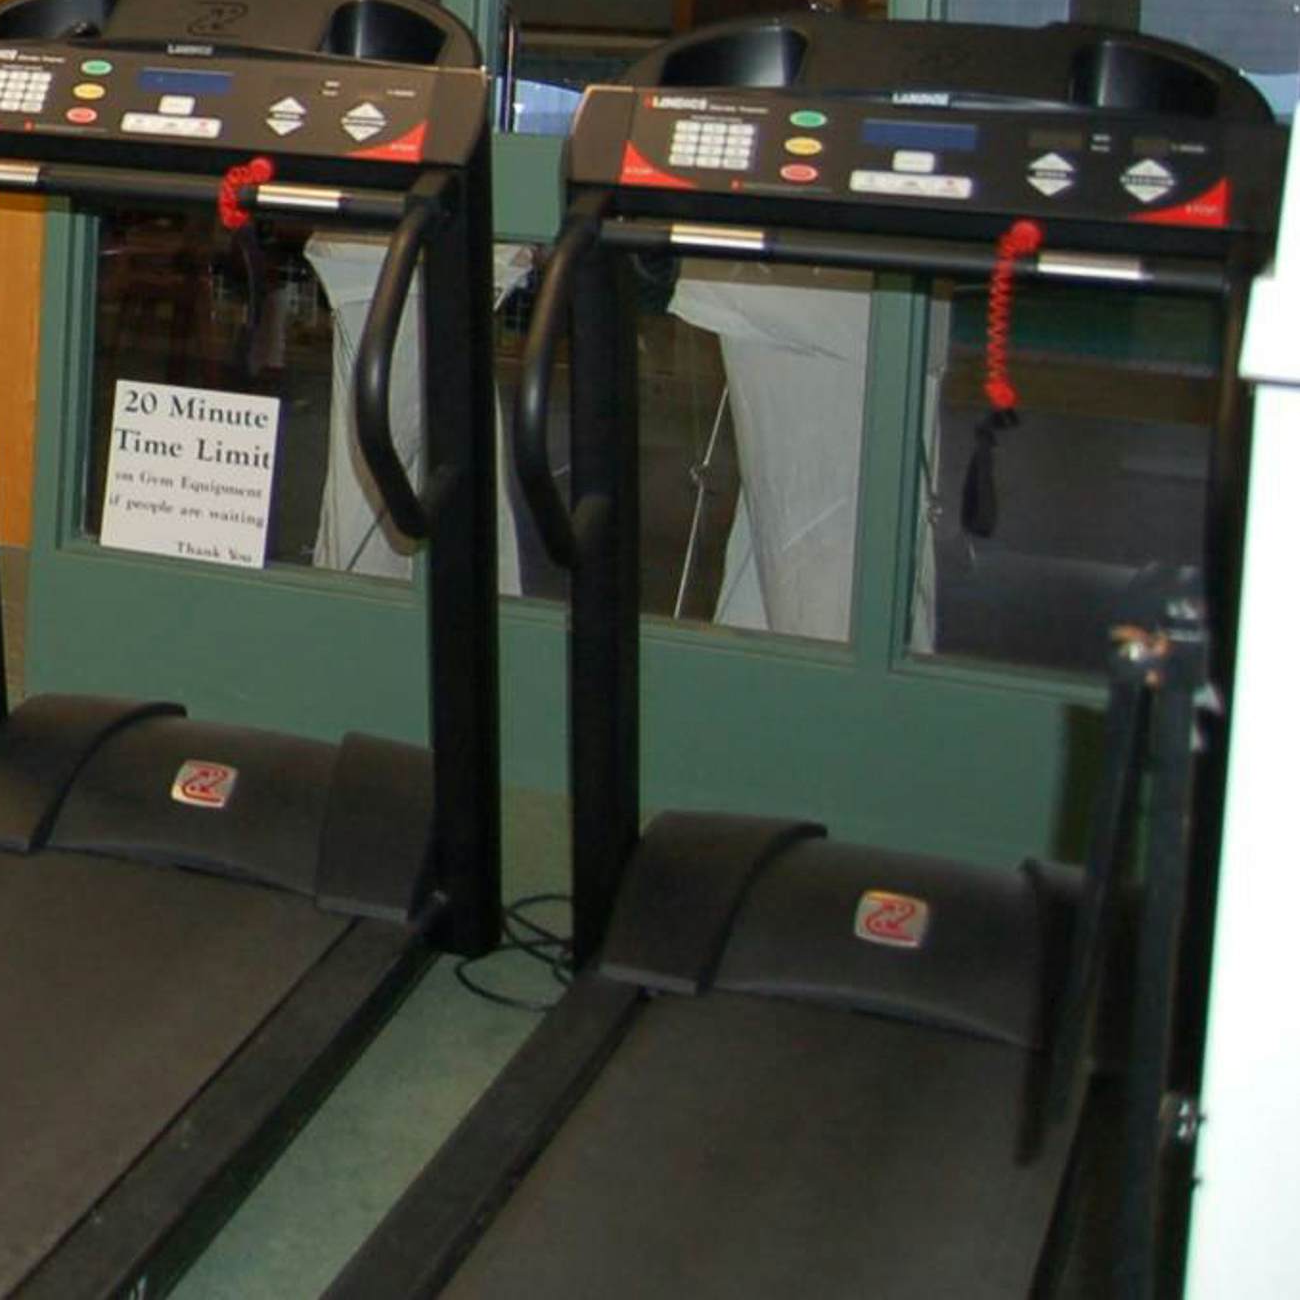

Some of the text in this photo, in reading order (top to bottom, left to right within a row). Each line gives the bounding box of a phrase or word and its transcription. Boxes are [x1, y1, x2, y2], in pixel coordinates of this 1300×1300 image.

[123, 388, 270, 429] 20 Minute
[114, 427, 272, 470] Time Limit
[180, 475, 263, 499] Equipment
[108, 494, 265, 529] if people are waiting
[176, 541, 253, 563] Thank You
